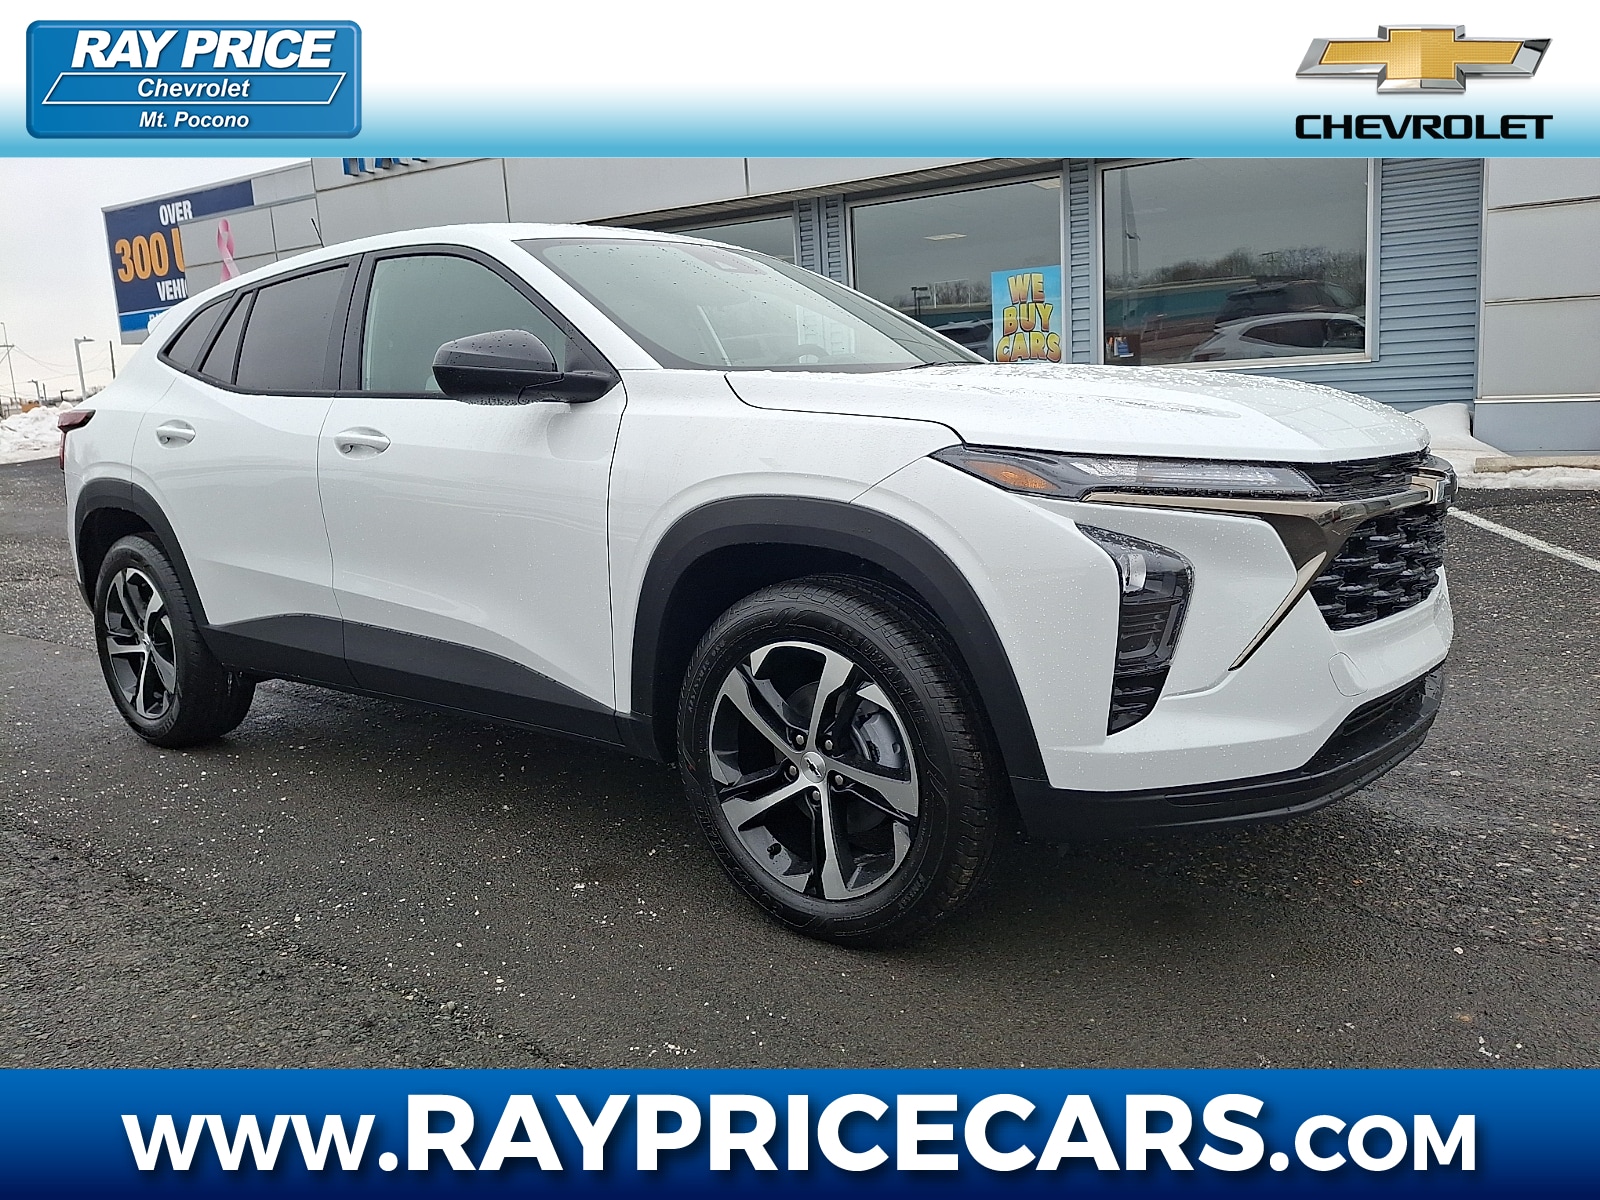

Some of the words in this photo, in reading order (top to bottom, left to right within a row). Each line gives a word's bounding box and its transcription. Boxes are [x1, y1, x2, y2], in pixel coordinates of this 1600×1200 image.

[159, 199, 194, 226] OVER
[115, 231, 169, 283] 300
[156, 277, 189, 302] VEHI
[1007, 271, 1045, 305] WE
[1002, 302, 1054, 336] BUY
[995, 331, 1062, 363] CARS
